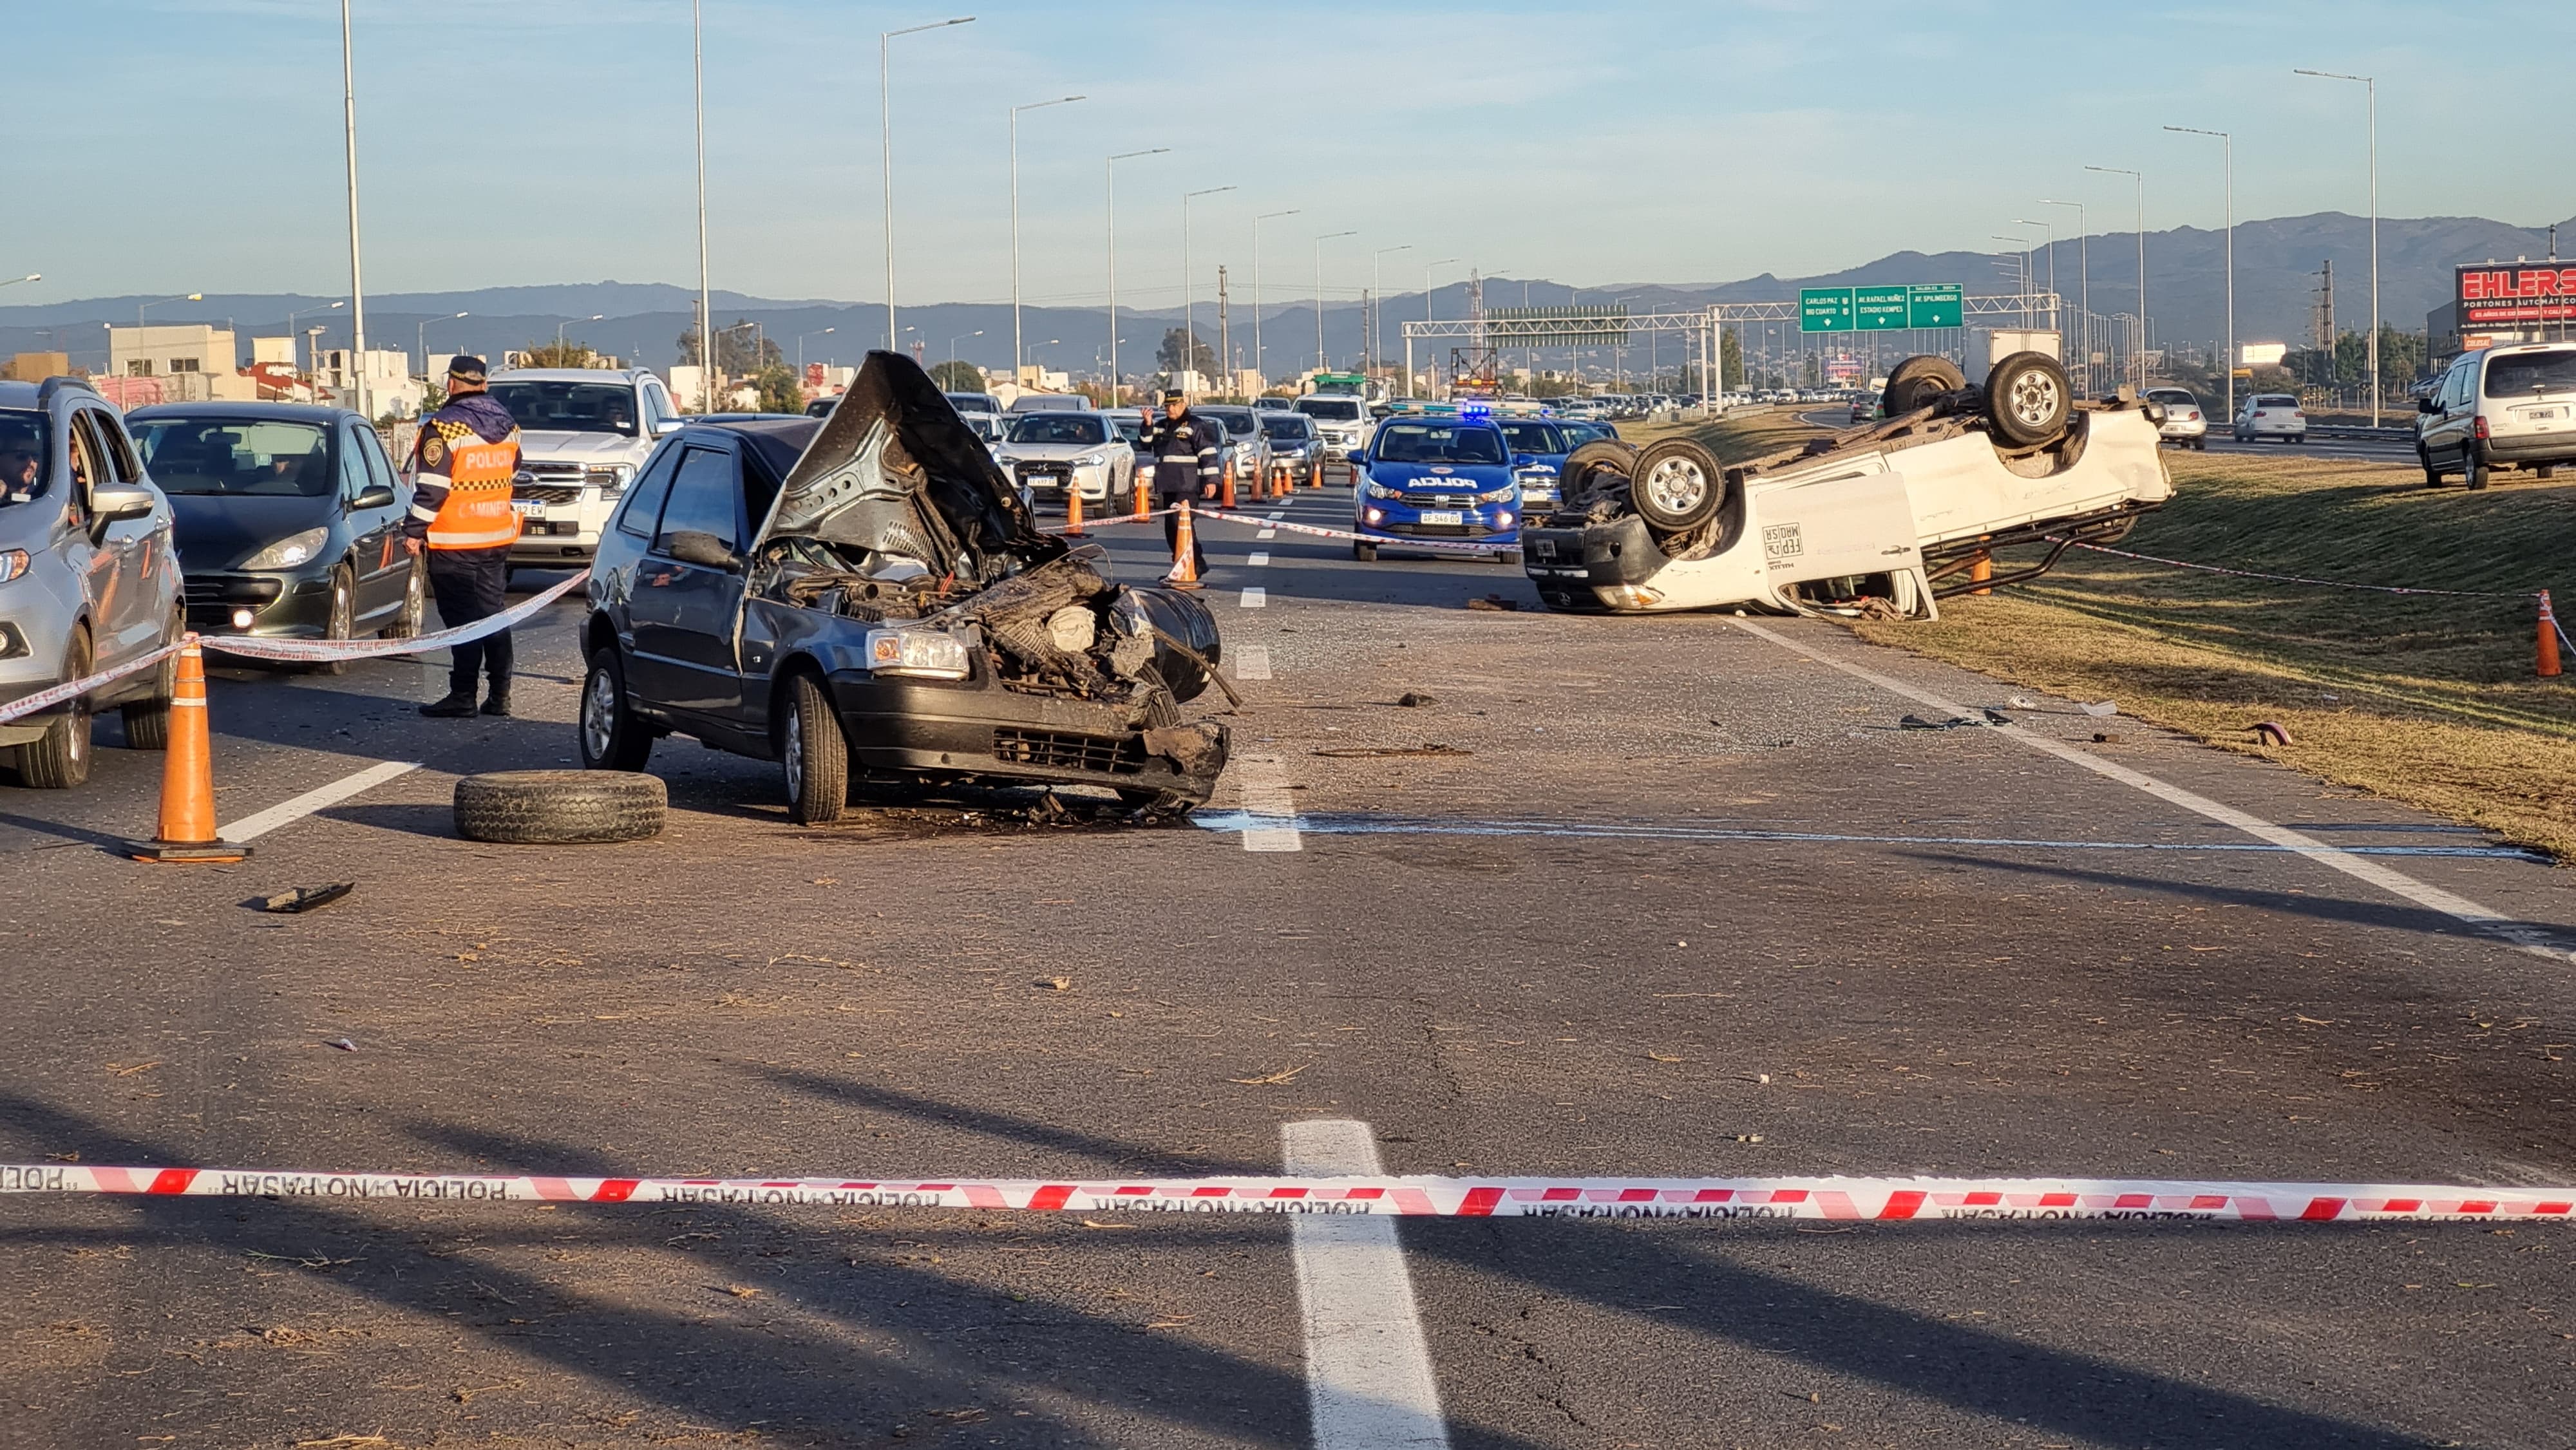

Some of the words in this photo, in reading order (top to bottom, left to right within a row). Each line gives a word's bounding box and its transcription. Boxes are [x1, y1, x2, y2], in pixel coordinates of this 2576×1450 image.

[2463, 269, 2576, 299] EHLERS
[2517, 297, 2576, 306] AUTOMÁTCO
[1783, 538, 1801, 554] FEP
[327, 1177, 367, 1198] NO
